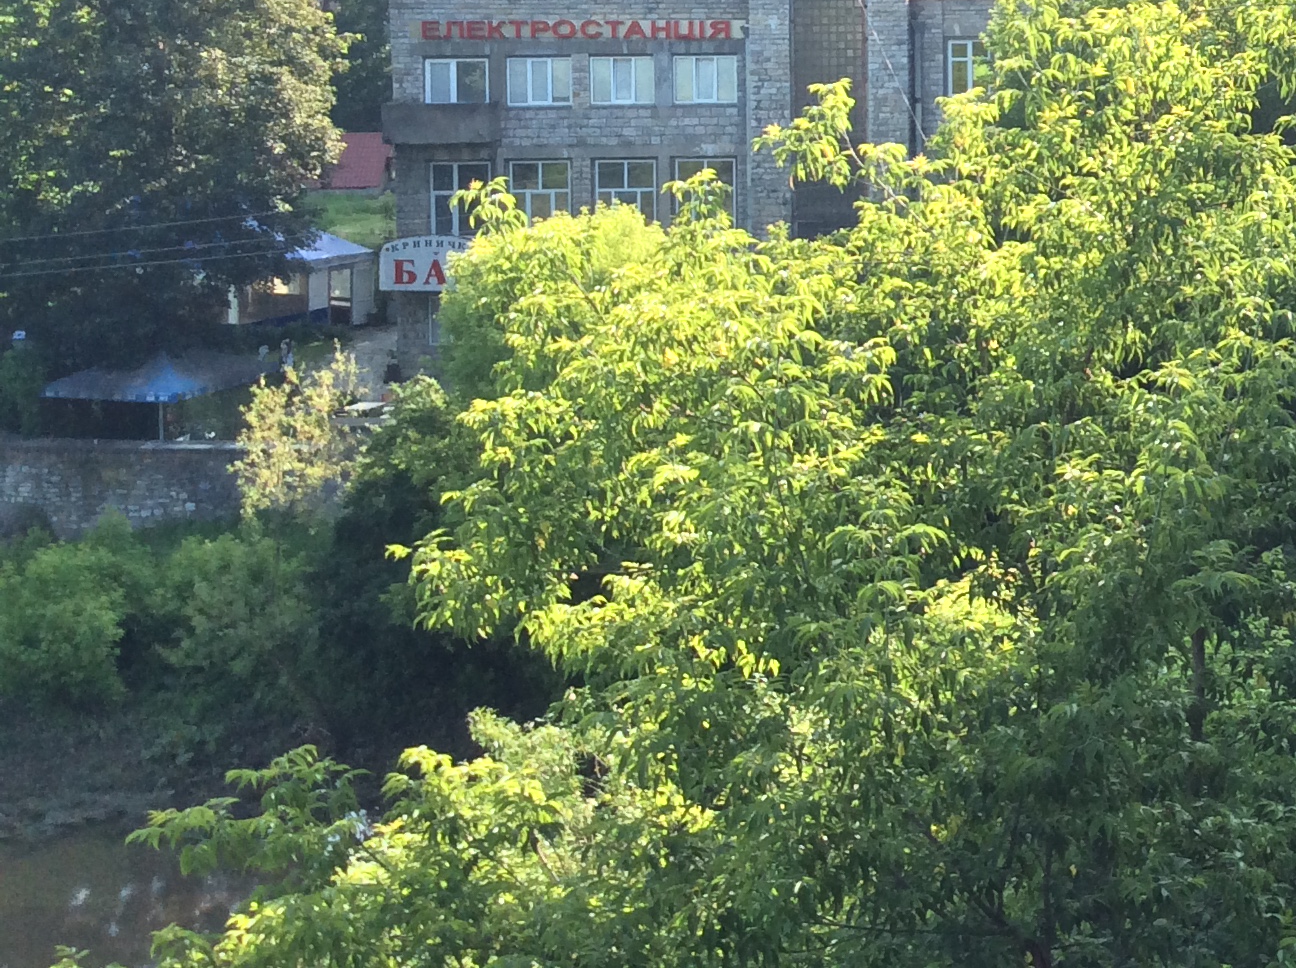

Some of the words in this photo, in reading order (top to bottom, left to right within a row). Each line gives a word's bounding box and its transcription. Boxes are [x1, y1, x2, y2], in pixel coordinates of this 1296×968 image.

[421, 19, 731, 41] ЕЛЕКТРОСТАНЦІЯ
[391, 239, 469, 252] КРИНИЧК
[393, 259, 447, 285] БА
